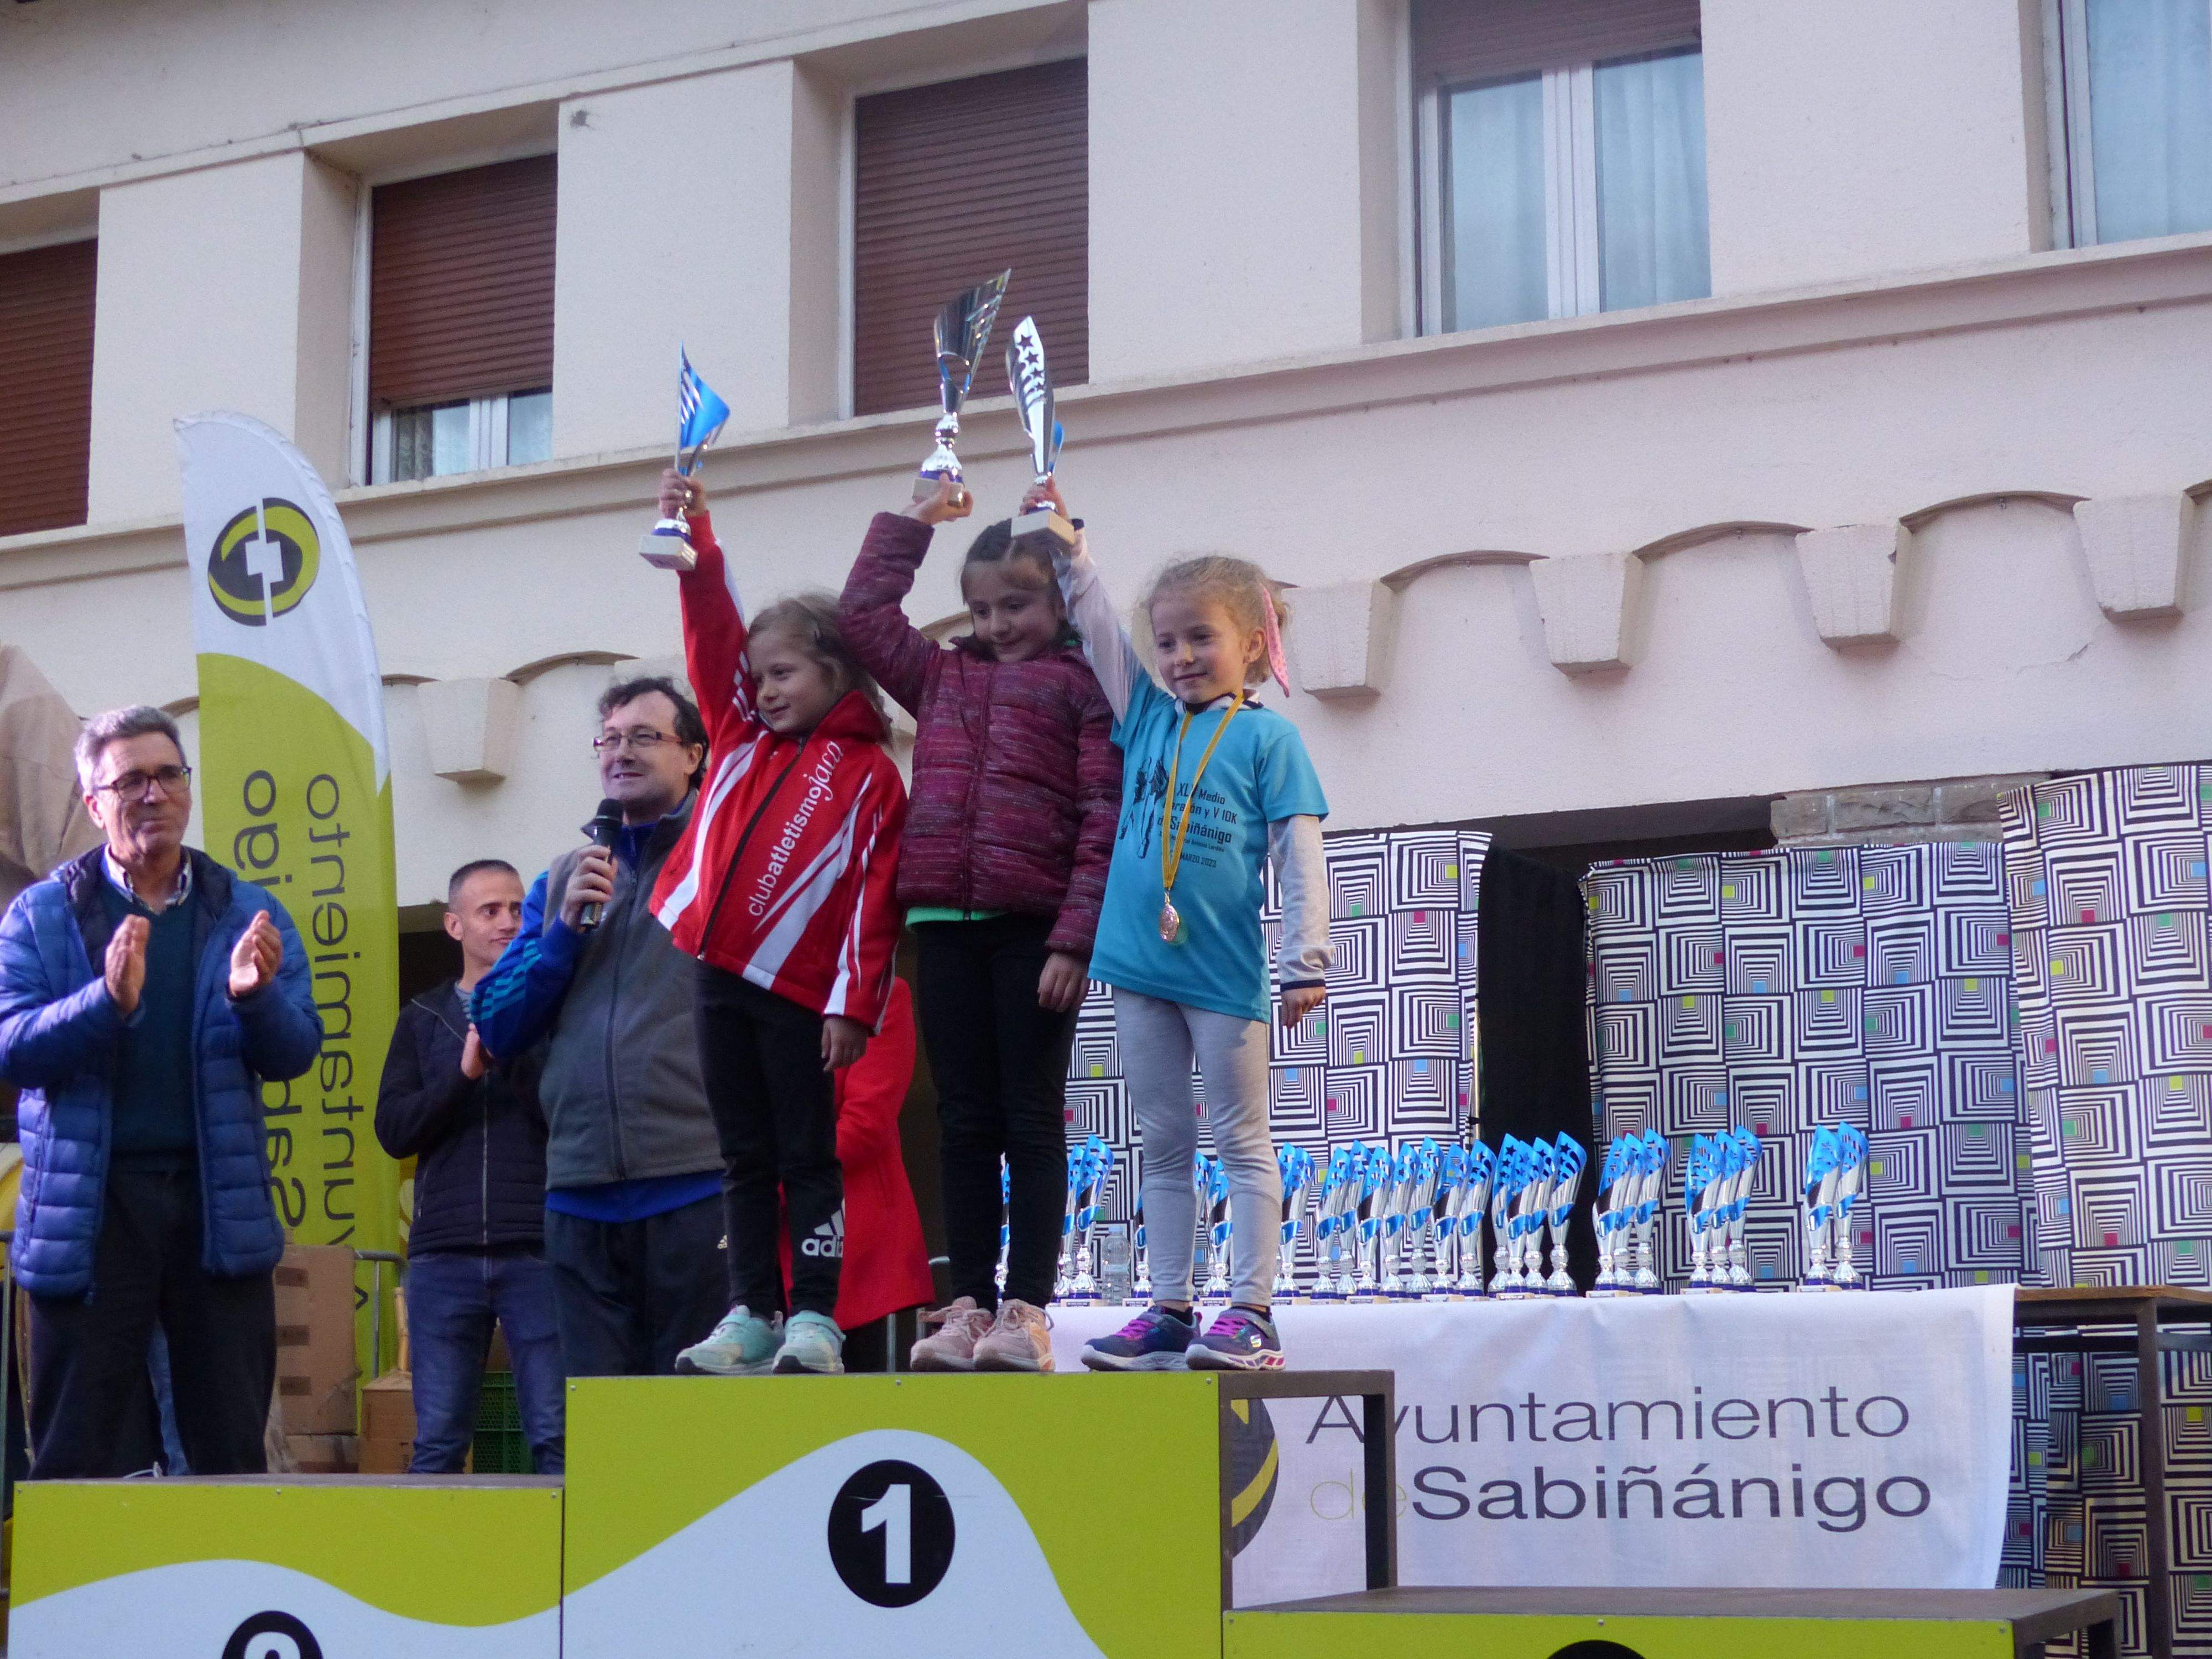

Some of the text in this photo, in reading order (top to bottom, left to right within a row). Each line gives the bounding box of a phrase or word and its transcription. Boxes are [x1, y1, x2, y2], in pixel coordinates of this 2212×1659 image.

[1170, 816, 1232, 844] Siñánigo
[1204, 808, 1210, 819] y
[1412, 1462, 1931, 1532] Sabiñánigo
[860, 1483, 911, 1584] 1
